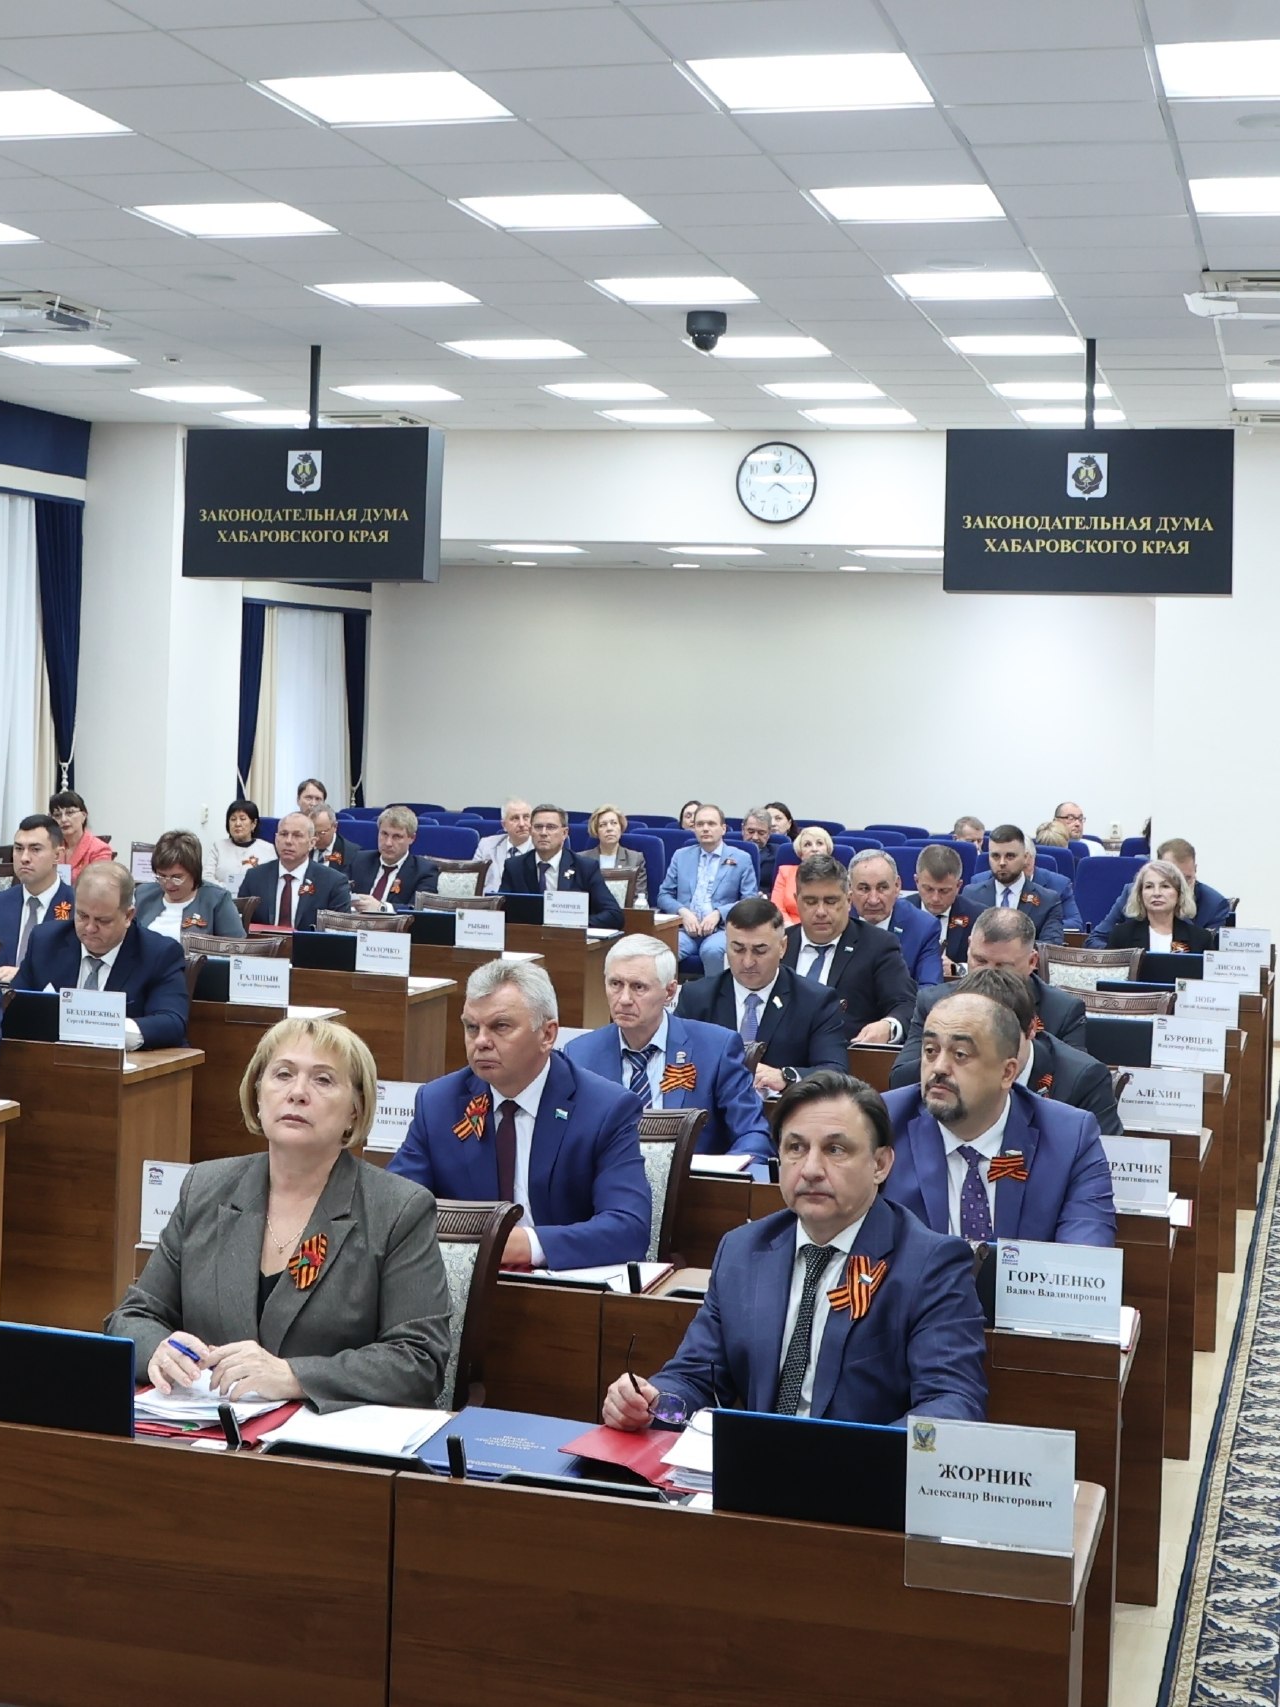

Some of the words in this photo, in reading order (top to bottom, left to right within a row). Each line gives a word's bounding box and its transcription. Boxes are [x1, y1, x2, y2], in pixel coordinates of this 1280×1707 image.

[199, 509, 357, 523] ЗАКОНОДАТЕЛЬНАЯ
[360, 509, 410, 523] ДУМА
[962, 515, 1151, 532] ЗАКОНОДАТЕЛЬНАЯ
[1155, 516, 1214, 534] ДУМА
[217, 530, 344, 543] ХАБАРОВСКОГО
[348, 530, 389, 543] КРАЯ
[984, 538, 1137, 553] ХАБАРОВСКОГО
[1141, 540, 1190, 555] КРАЯ
[1164, 1034, 1213, 1045] БУРОВЦЕВ
[376, 1106, 415, 1117] ЛИТВИ
[1108, 1161, 1163, 1175] РАТЧИК
[1008, 1270, 1106, 1289] ГОРУЛЕНКО
[1006, 1285, 1036, 1296] Вадим
[938, 1463, 1033, 1488] ЖОРНИК
[918, 1485, 979, 1502] Александр
[982, 1492, 1053, 1509] Викторович
